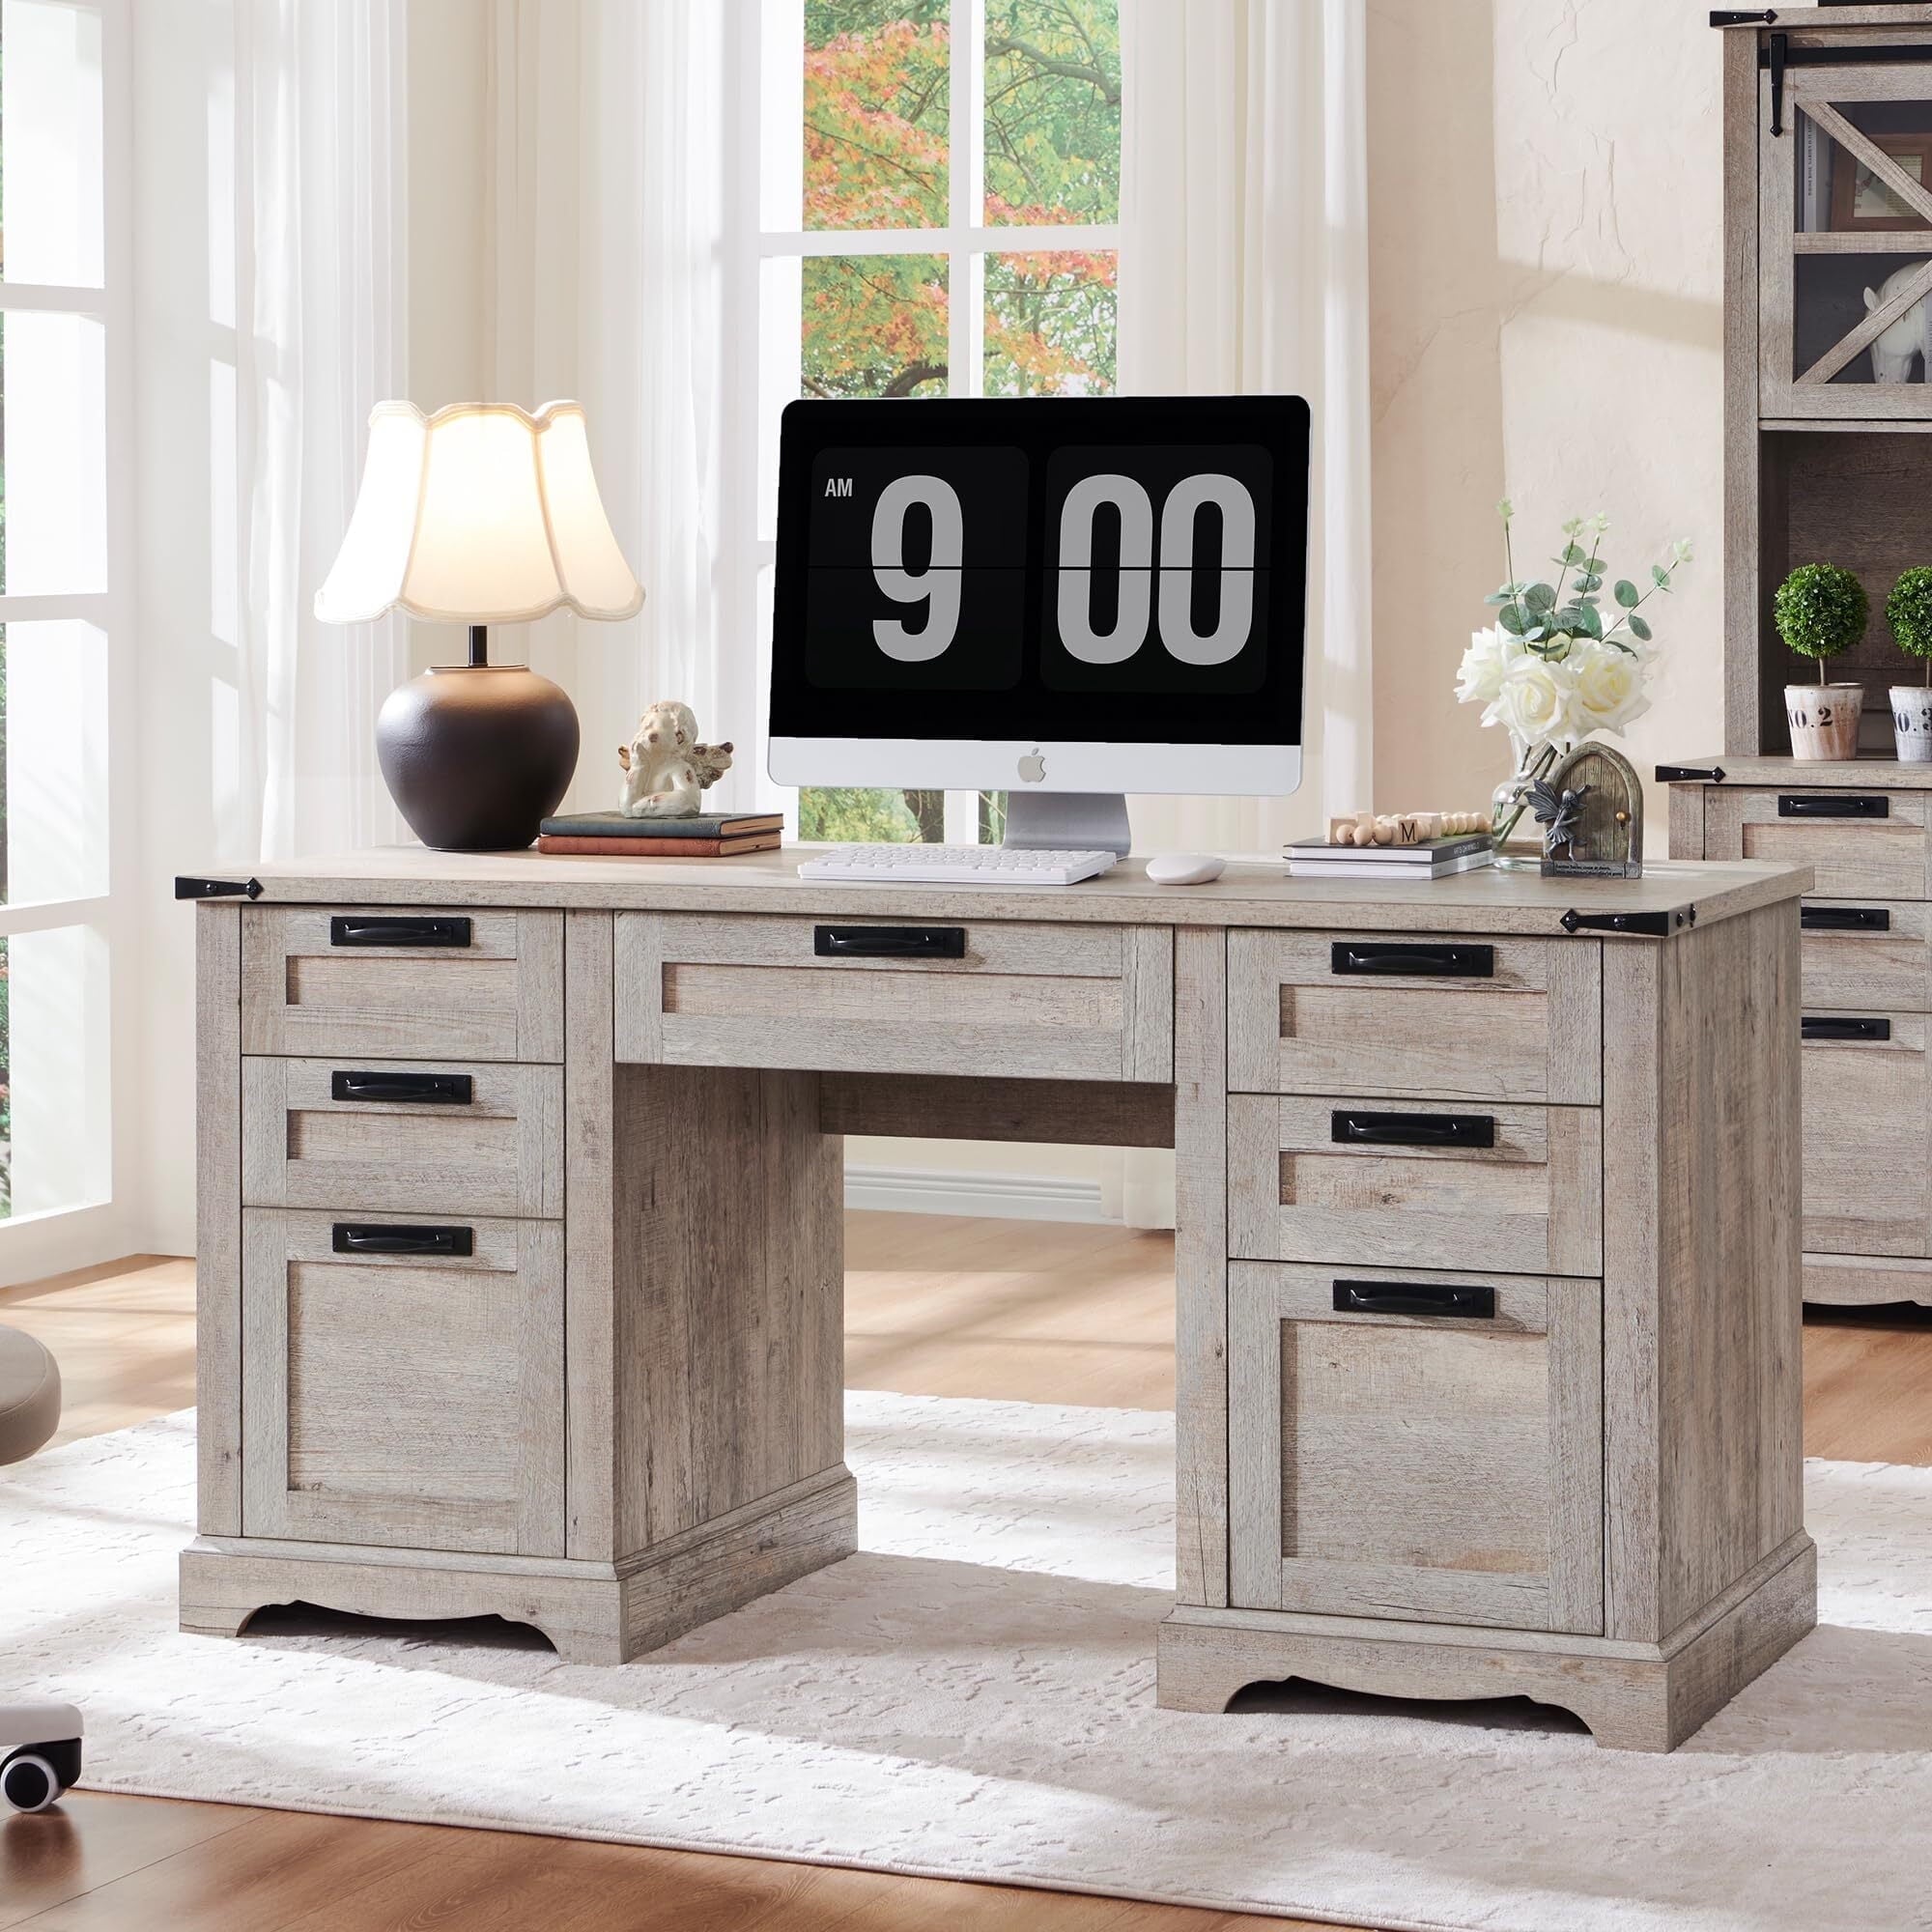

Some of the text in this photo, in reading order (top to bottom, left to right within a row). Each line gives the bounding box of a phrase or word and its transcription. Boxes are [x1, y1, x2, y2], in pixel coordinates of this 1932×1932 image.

[824, 477, 853, 497] AM
[870, 472, 1256, 666] 9 00
[1401, 822, 1416, 842] M
